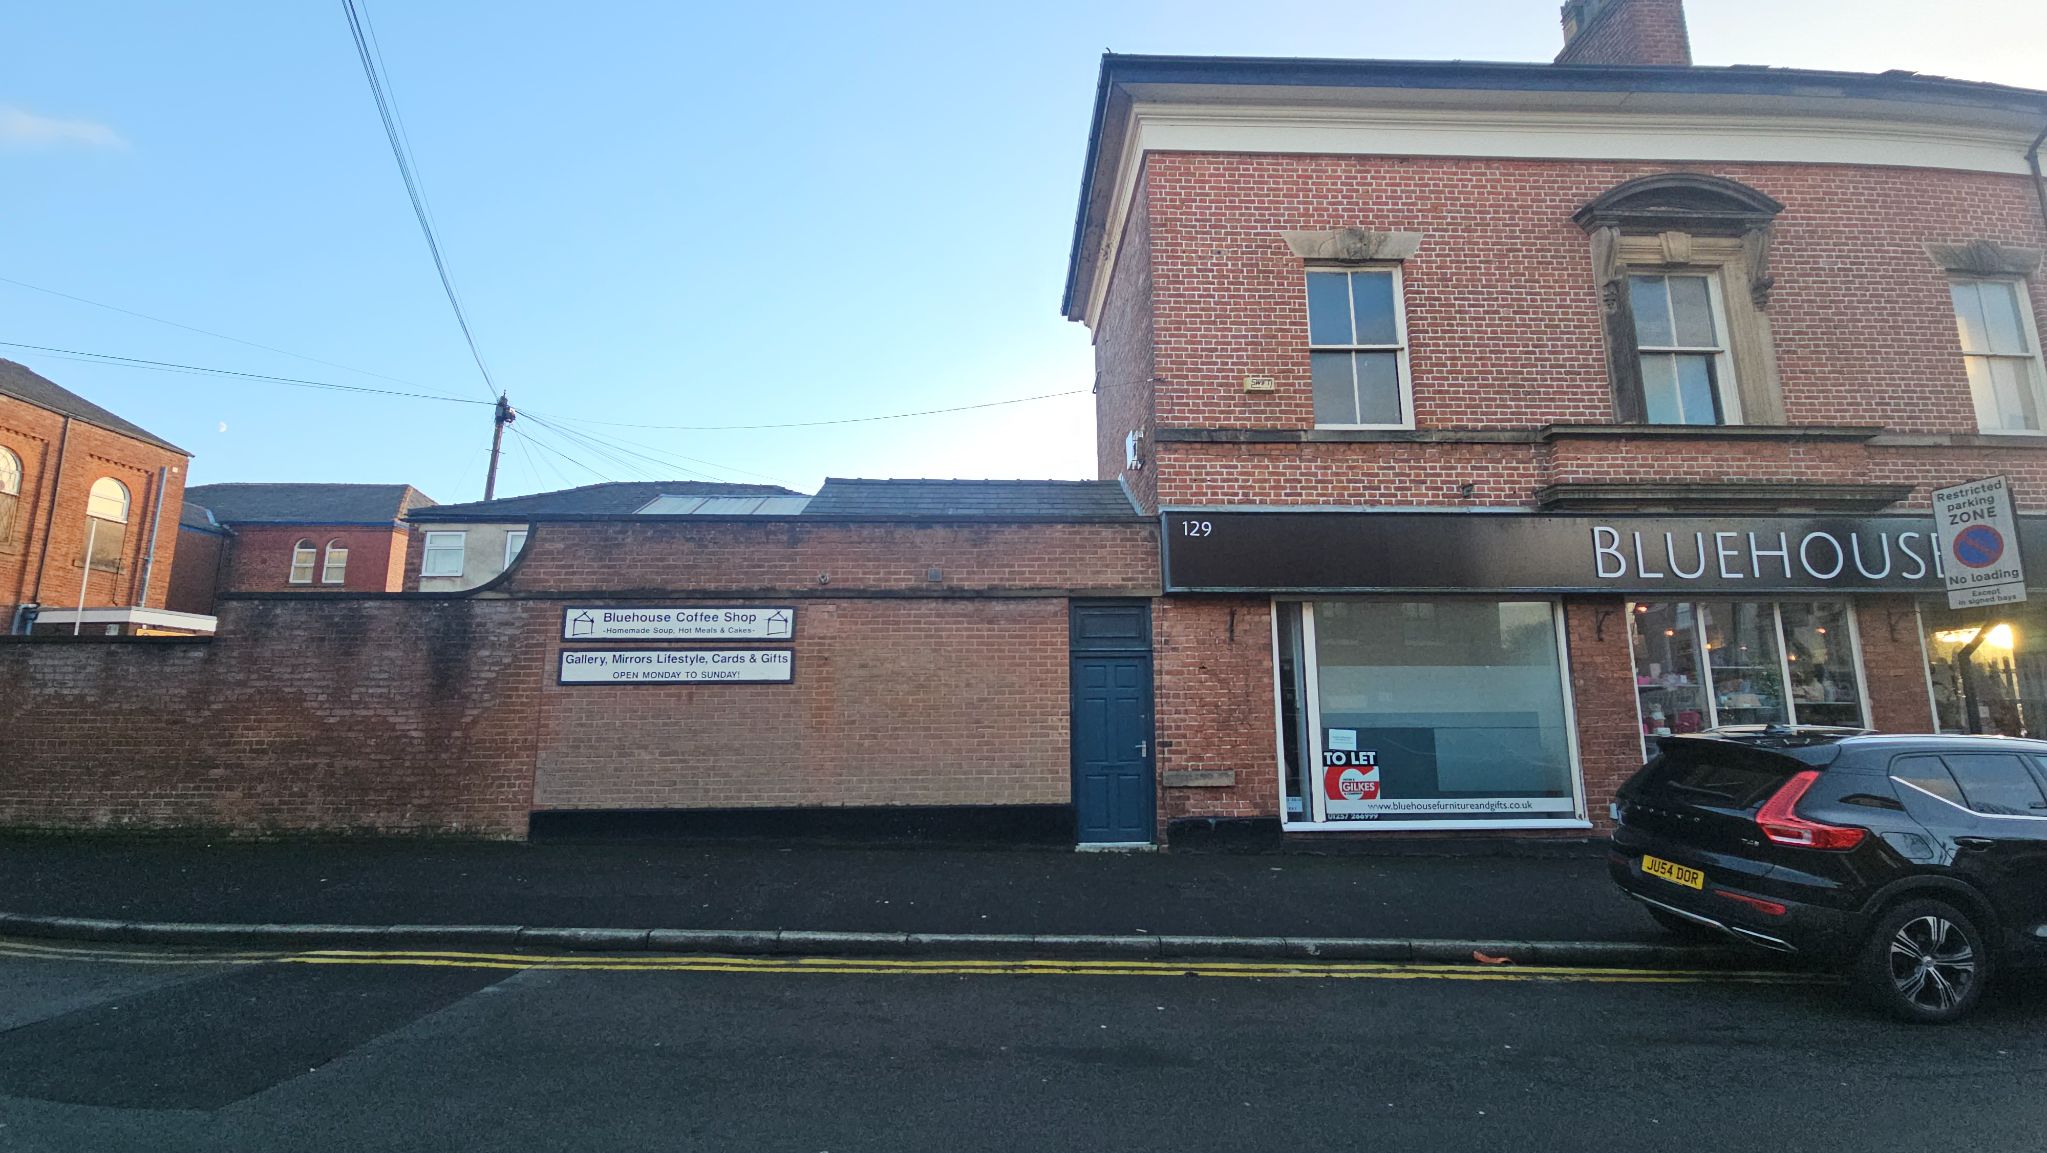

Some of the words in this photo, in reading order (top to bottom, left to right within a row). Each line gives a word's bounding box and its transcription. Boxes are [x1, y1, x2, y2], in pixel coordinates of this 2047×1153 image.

[1937, 481, 2002, 503] Restricted
[1947, 495, 1995, 512] parking
[1949, 506, 1998, 525] ZONE
[1182, 520, 1212, 537] 129
[1949, 575, 1968, 586] No
[1971, 569, 2019, 583] loading
[1972, 588, 2001, 597] Except
[1968, 596, 1995, 605] signed
[1998, 594, 2017, 602] bays
[603, 612, 671, 623] Bluehouse
[676, 612, 719, 622] Coffee
[724, 612, 757, 624] Shop
[653, 627, 676, 635] Soup,
[566, 654, 608, 666] Gallery,
[612, 654, 653, 664] Mirrors
[657, 654, 708, 666] Lifestyle,
[712, 653, 746, 664] Cards
[749, 653, 757, 663] &
[761, 653, 788, 663] Gifts
[612, 671, 639, 679] OPEN
[642, 671, 681, 679] MONDAY
[685, 671, 698, 679] TO
[701, 671, 740, 679] SUNDAY!
[1323, 751, 1347, 765] TO
[1350, 751, 1376, 765] LET
[1342, 782, 1375, 791] GILKES
[1367, 801, 1533, 812] www.bluehousefurnitureandgifts.co.uk
[1646, 859, 1673, 877] JU54
[1676, 868, 1699, 885] DOR
